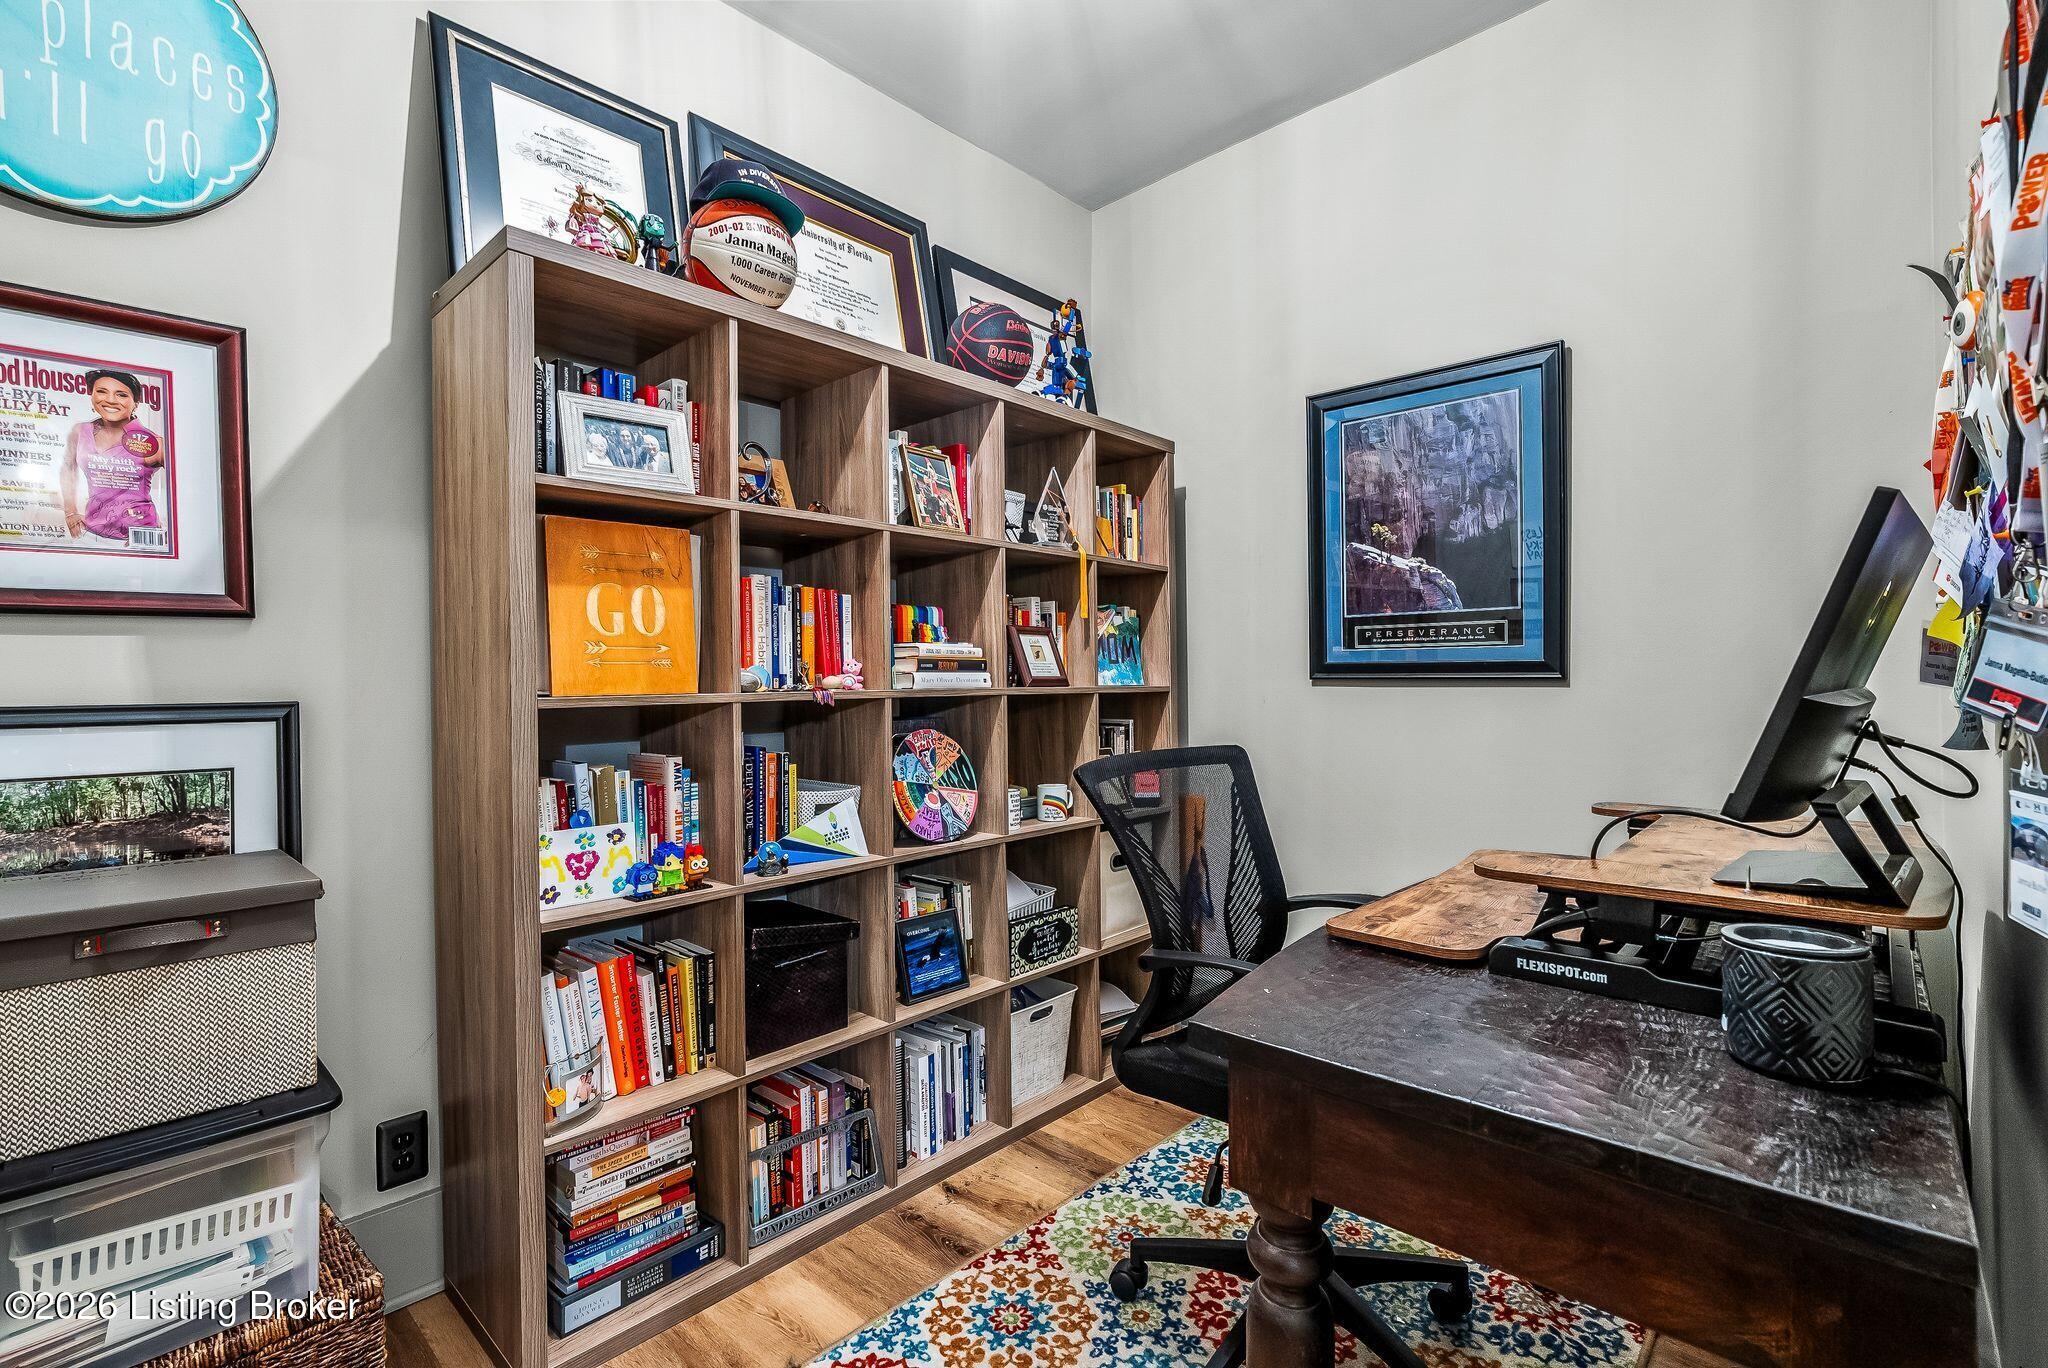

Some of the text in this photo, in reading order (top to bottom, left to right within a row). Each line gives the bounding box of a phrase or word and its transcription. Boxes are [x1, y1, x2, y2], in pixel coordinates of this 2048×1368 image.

[40, 0, 246, 113] places
[0, 69, 201, 184] 'll go
[2010, 152, 2048, 232] POWER
[708, 222, 744, 237] 2001-02
[725, 233, 764, 253] Janna
[799, 225, 876, 263] University of Florida
[731, 255, 793, 285] 1,000 Career Points
[730, 273, 775, 298] NOVEMBER 17,
[24, 358, 161, 412] Houseng
[38, 402, 70, 416] FAT
[34, 432, 59, 441] You!
[33, 525, 65, 533] DEALS
[586, 582, 666, 637] GO
[757, 595, 765, 633] Atomic
[1365, 625, 1496, 638] PERSEVERANCE
[1929, 641, 1957, 652] POWER
[1985, 657, 2048, 685] Janna Magette-Butle
[745, 763, 753, 789] DEEP
[579, 778, 589, 810] SOAR
[674, 762, 683, 826] AWAKE JEN
[683, 777, 691, 827] SOUL DETOX
[825, 831, 849, 843] LEADERS
[1516, 957, 1608, 984] FLEXISPOT.com
[544, 986, 556, 1026] BECOMING
[586, 978, 602, 1020] PEAK
[608, 964, 616, 994] Smarter
[616, 1020, 624, 1042] Better
[629, 986, 637, 1015] GOOD
[577, 1012, 585, 1034] COLORS
[634, 1021, 639, 1032] TO
[651, 1031, 657, 1041] TO
[662, 1016, 671, 1046] LEADERSHIP
[635, 1037, 645, 1071] GREAT
[626, 1126, 648, 1137] CAPTAIN'S
[648, 1118, 671, 1129] LEADERSHIP
[577, 1140, 630, 1164] StrengthsQuest
[597, 1164, 607, 1172] THE
[608, 1158, 622, 1167] SPEED
[631, 1148, 647, 1158] TRUST
[600, 1156, 665, 1188] HIGHLY EFFECTIVE PEOPLE
[770, 1172, 778, 1205] HOLLANDER
[577, 1195, 645, 1226] The Effective Executive
[617, 1212, 655, 1231] LEARNING
[664, 1201, 682, 1211] LEAD
[630, 1212, 675, 1236] FIND YOUR WHY
[755, 1204, 820, 1242] DAVIDSON
[610, 1238, 644, 1256] Learning
[655, 1222, 680, 1238] LEAD
[627, 1264, 664, 1284] LEARNING
[627, 1288, 642, 1298] TEAM
